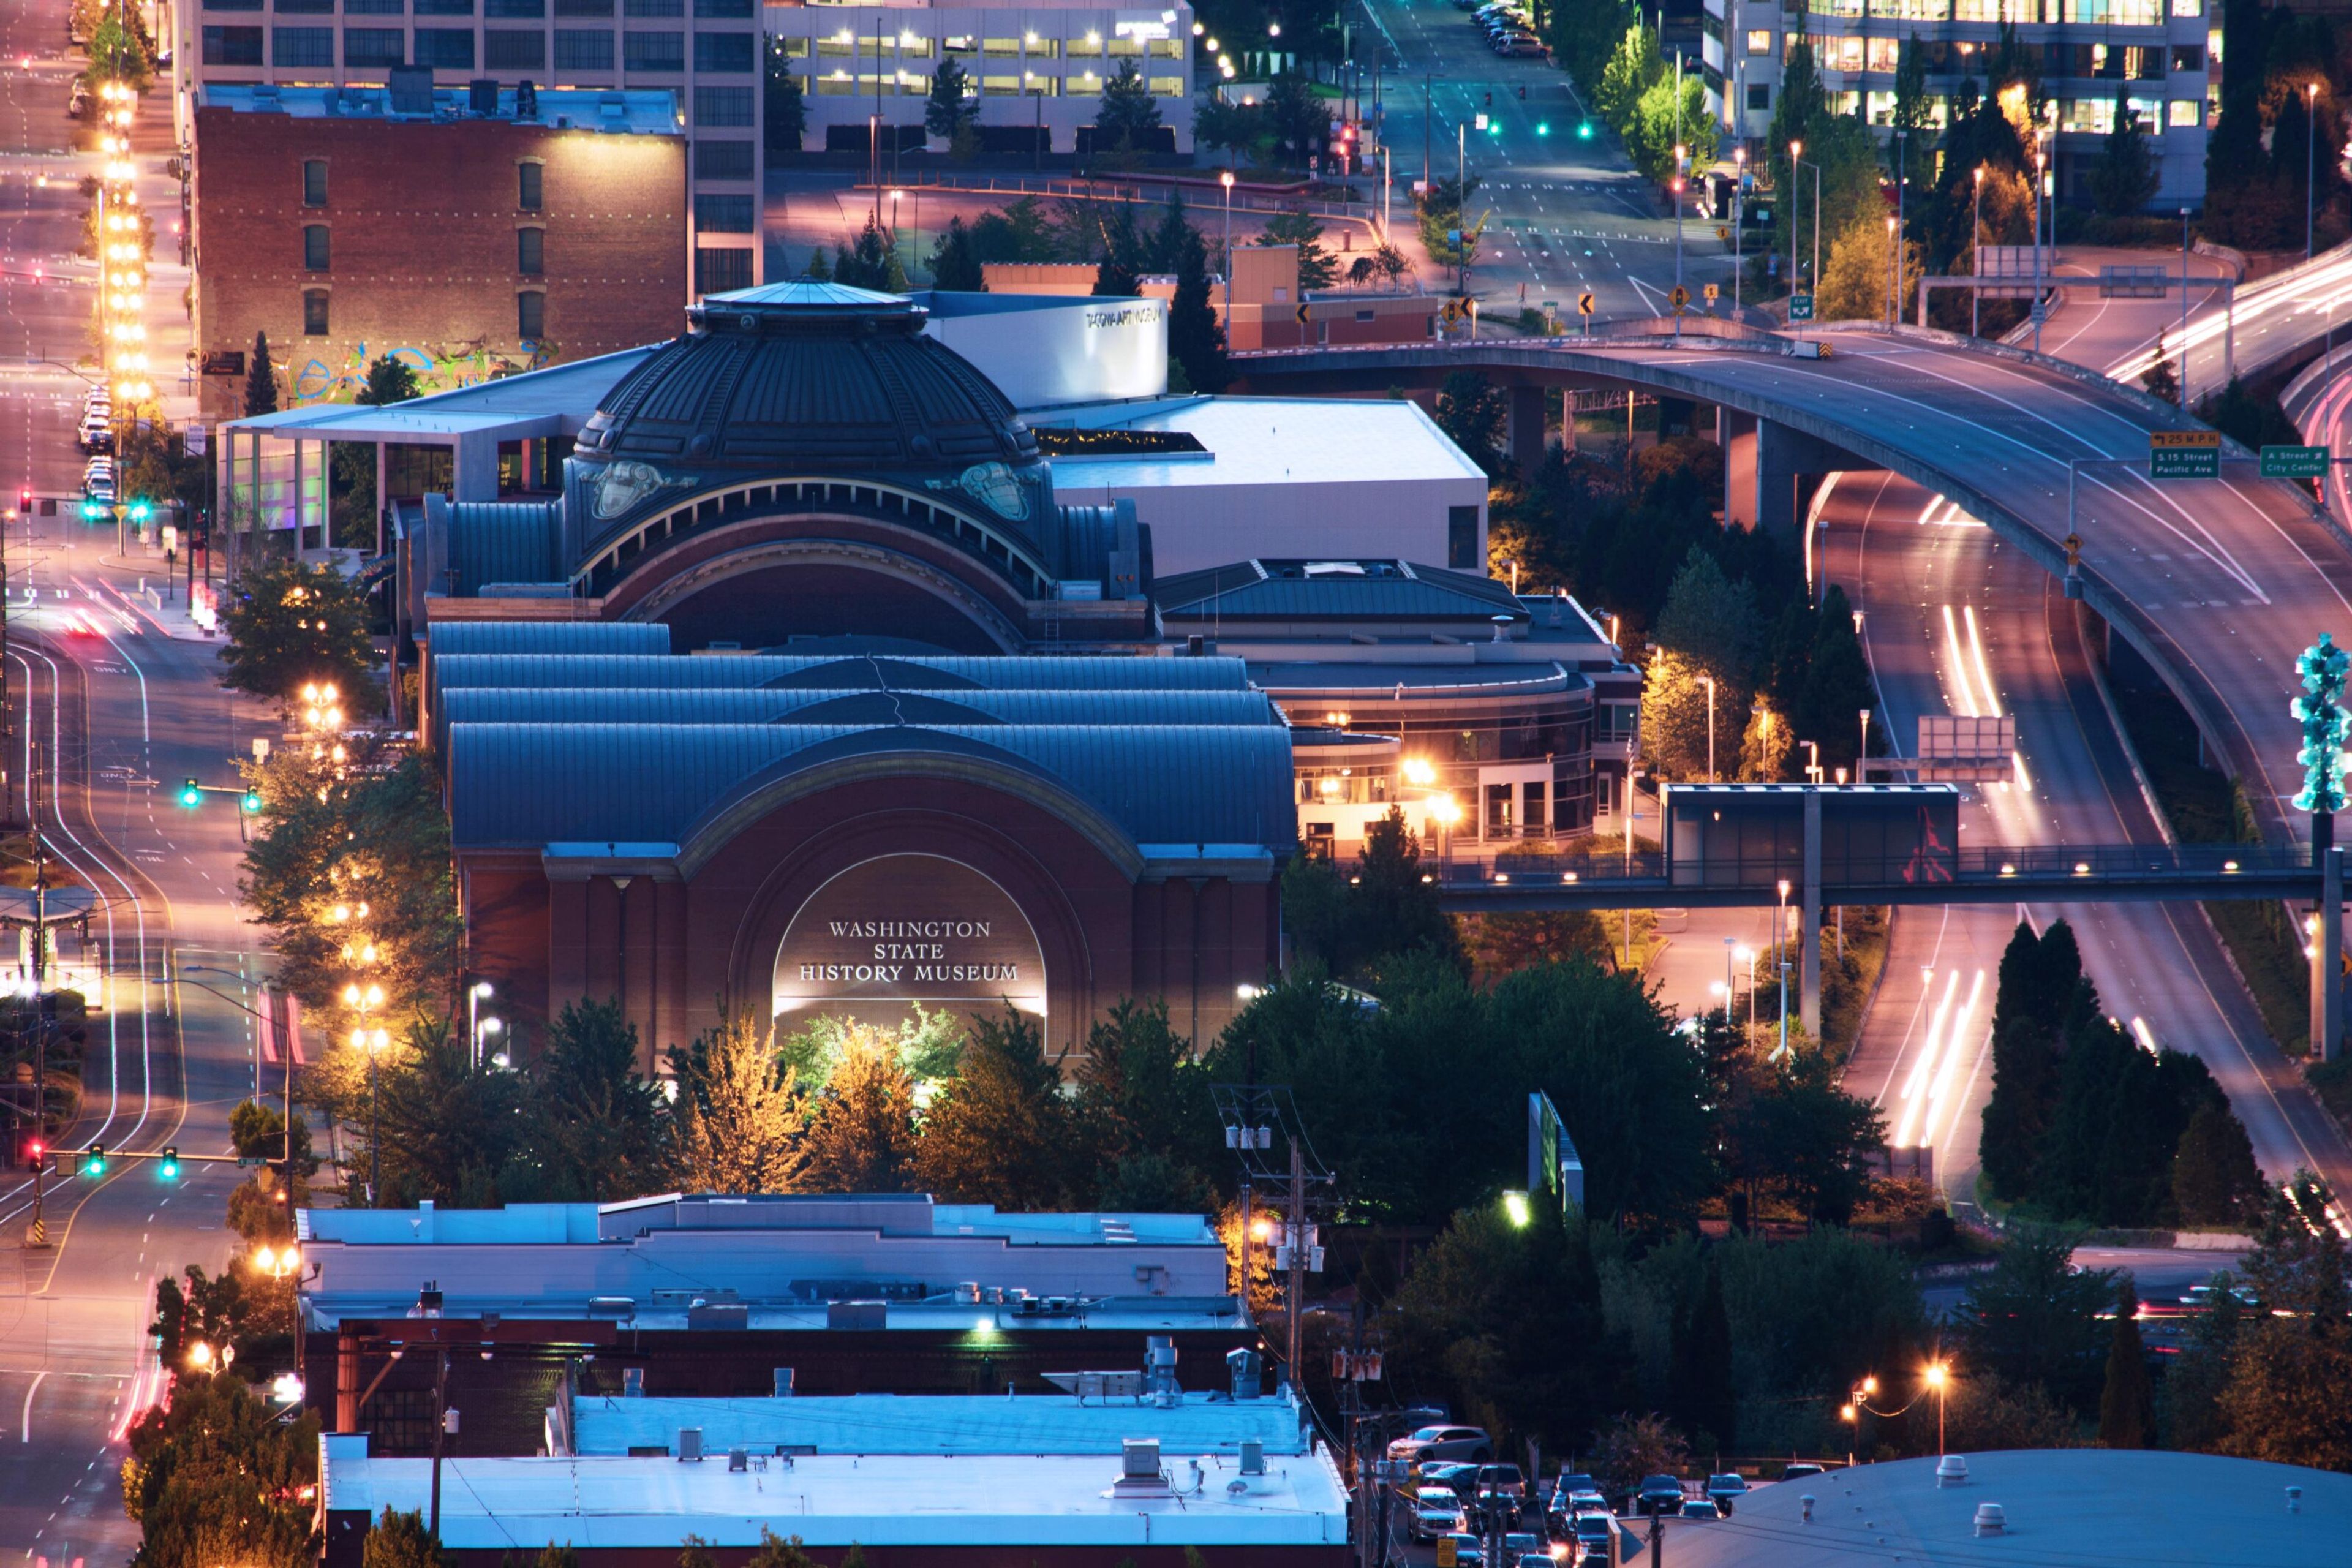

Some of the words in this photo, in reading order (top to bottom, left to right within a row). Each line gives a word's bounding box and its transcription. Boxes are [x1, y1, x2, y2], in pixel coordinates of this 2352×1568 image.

[1086, 312, 1116, 328] TACOMA
[1117, 309, 1132, 325] ART
[2169, 434, 2182, 444] 25
[2267, 464, 2286, 473] City
[829, 921, 991, 938] WASHINGTON
[874, 943, 944, 960] STATE
[799, 965, 903, 982] HISTORY
[913, 965, 1019, 981] MUSEUM
